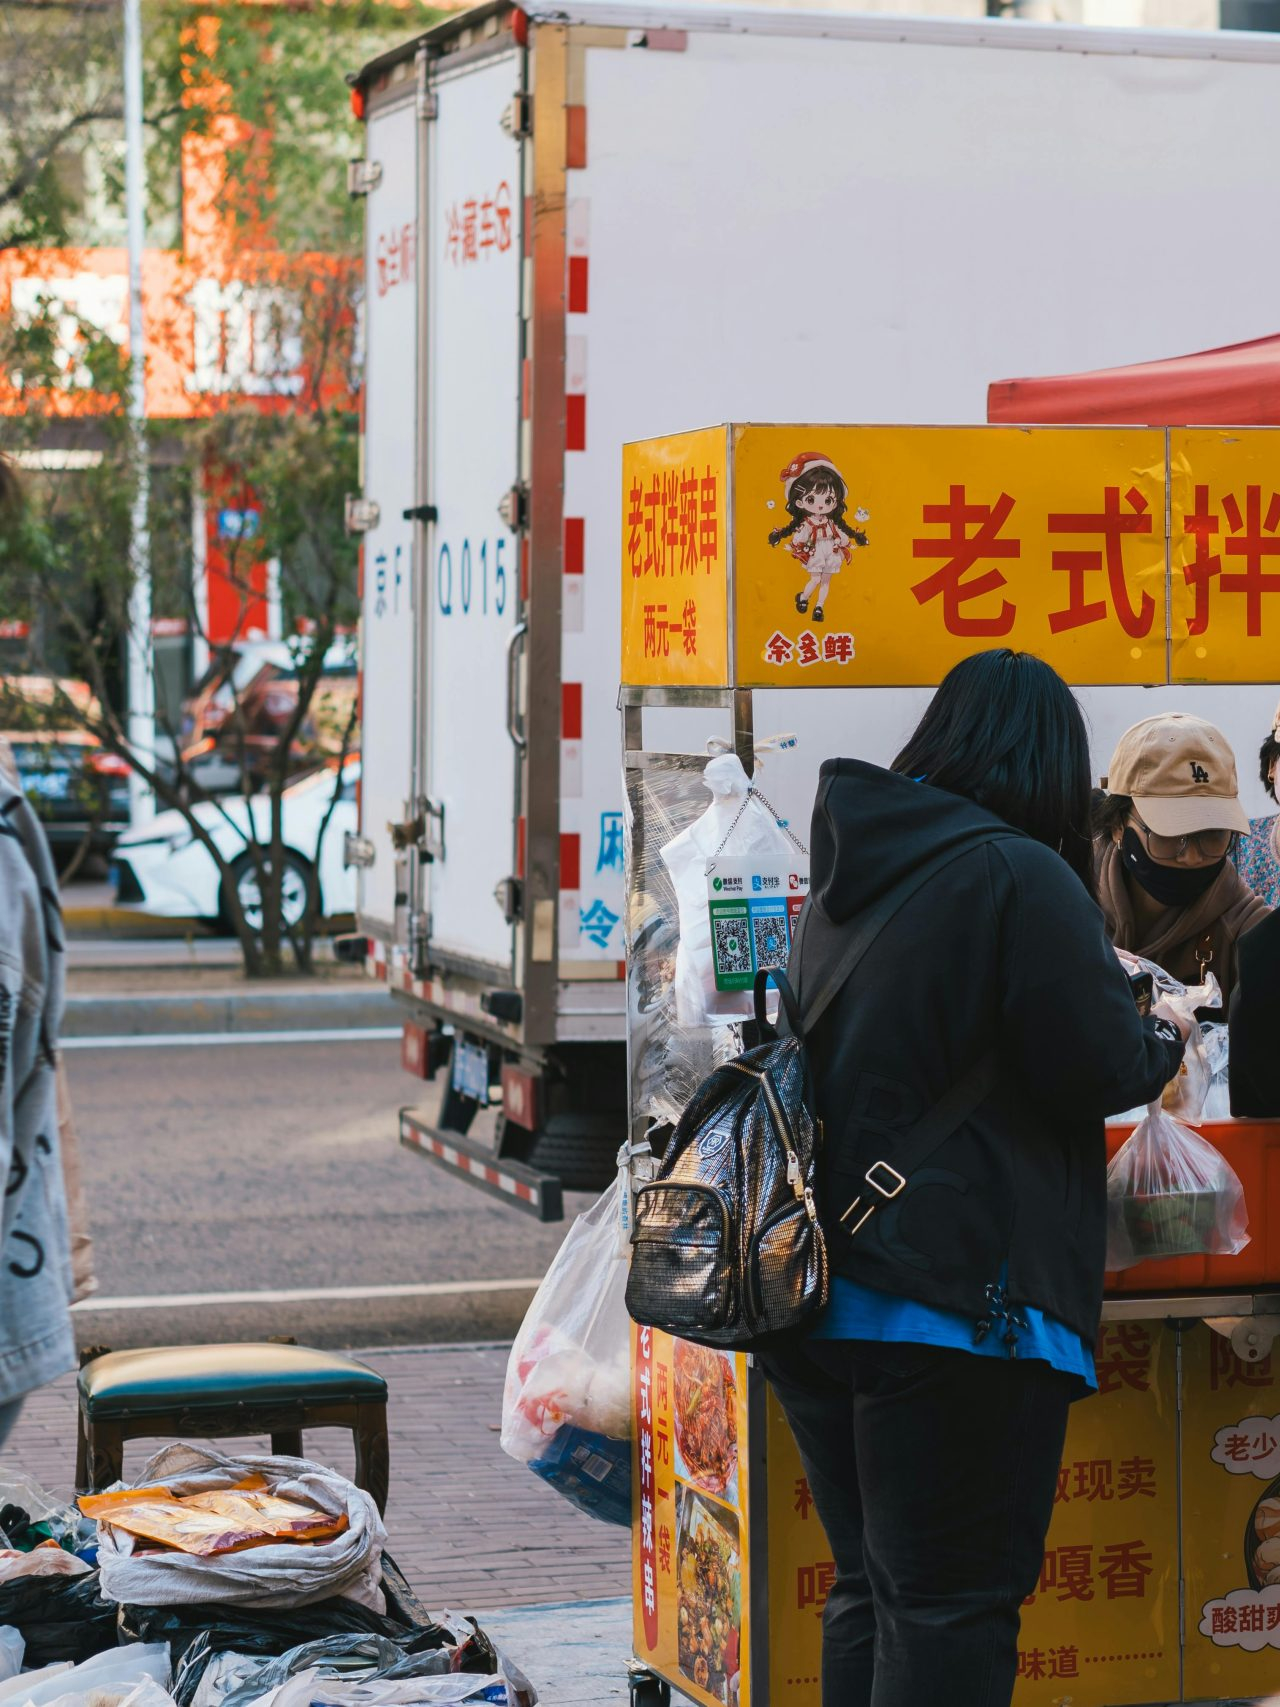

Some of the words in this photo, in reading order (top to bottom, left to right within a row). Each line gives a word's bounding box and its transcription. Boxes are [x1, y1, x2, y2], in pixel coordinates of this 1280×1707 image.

[627, 464, 718, 581] 老式拌辣串
[643, 600, 698, 659] 两元一袋
[765, 630, 856, 667] 余多鲜
[1189, 761, 1209, 784] LA
[579, 900, 620, 949] 冷
[1096, 1324, 1151, 1393] 袋
[656, 1362, 671, 1575] 两元一袋
[1022, 1539, 1154, 1606] 嘎香
[1016, 1644, 1080, 1682] 味道
